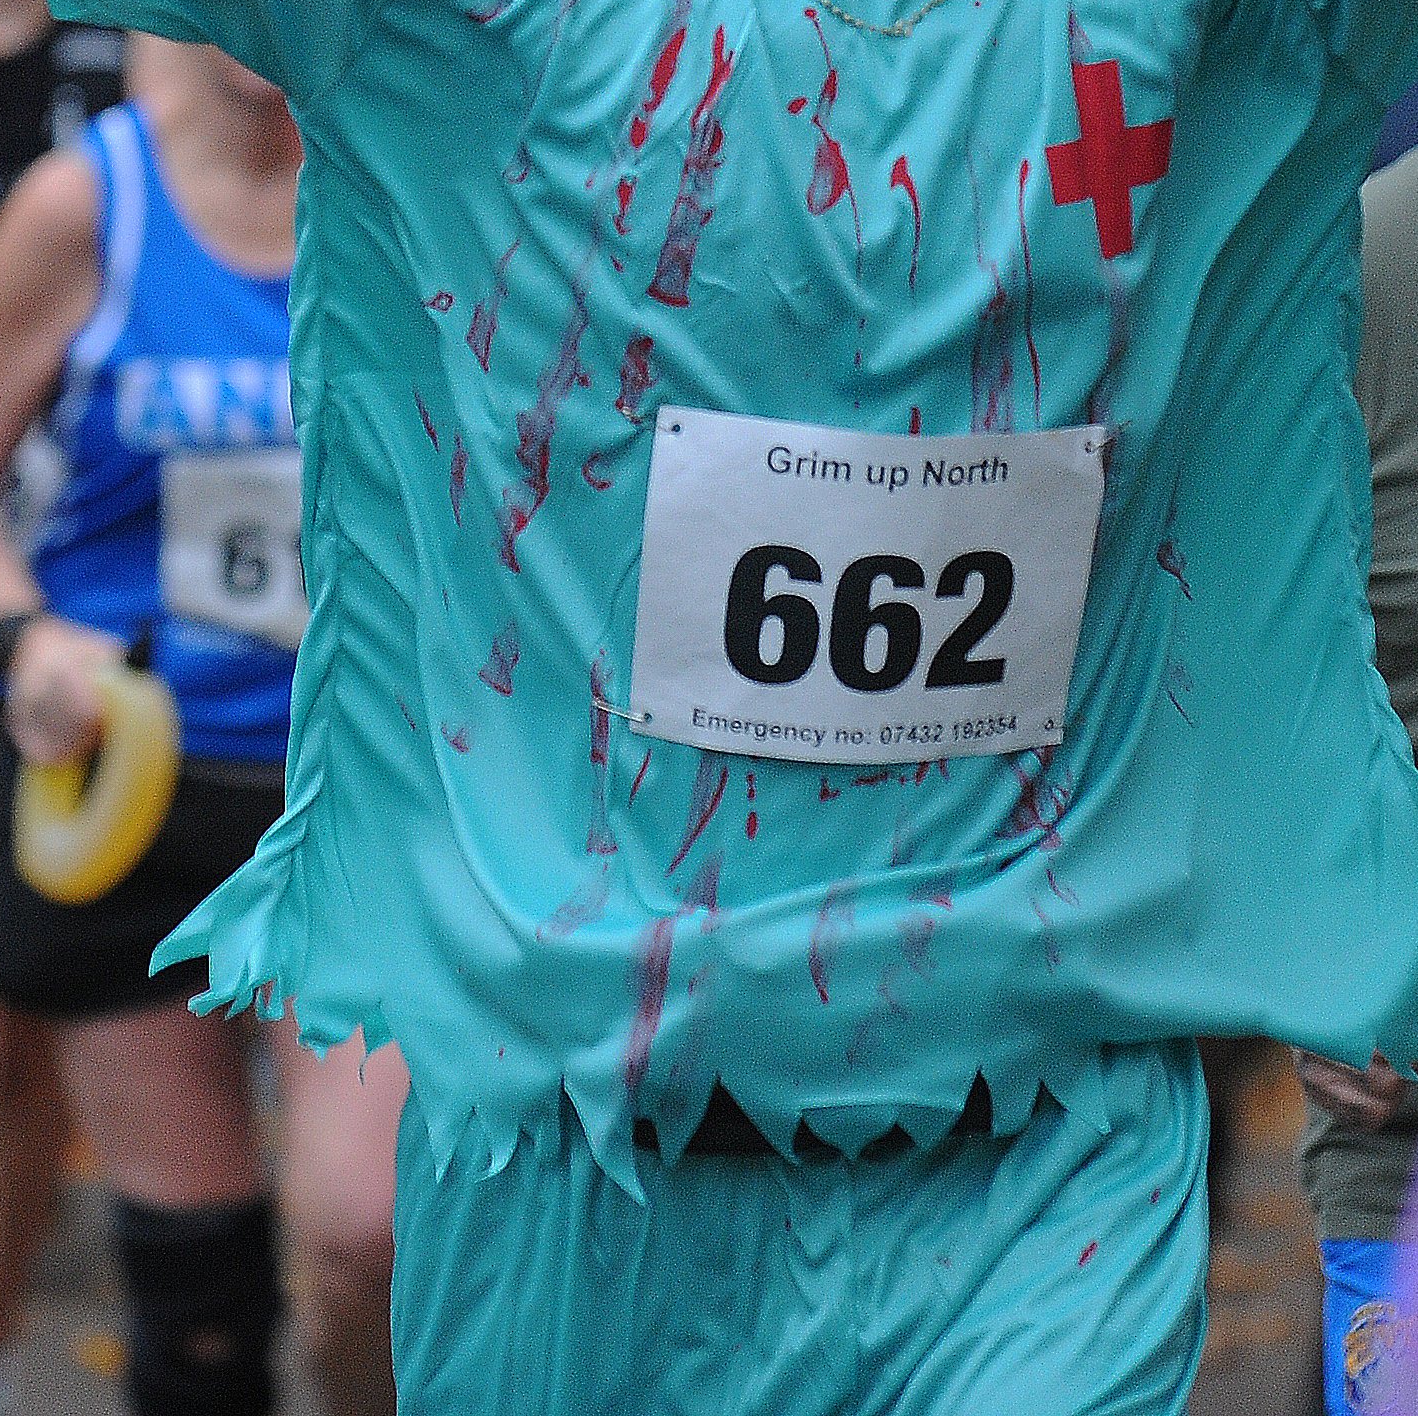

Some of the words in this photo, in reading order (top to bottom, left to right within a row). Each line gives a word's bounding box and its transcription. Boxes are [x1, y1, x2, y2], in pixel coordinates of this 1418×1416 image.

[767, 446, 851, 481] Grim
[867, 464, 910, 493] up
[922, 456, 1009, 488] North
[219, 520, 300, 597] 6
[723, 544, 1015, 695] 662
[692, 707, 826, 748] Emergency
[835, 728, 872, 745] no:
[880, 723, 944, 745] 07432
